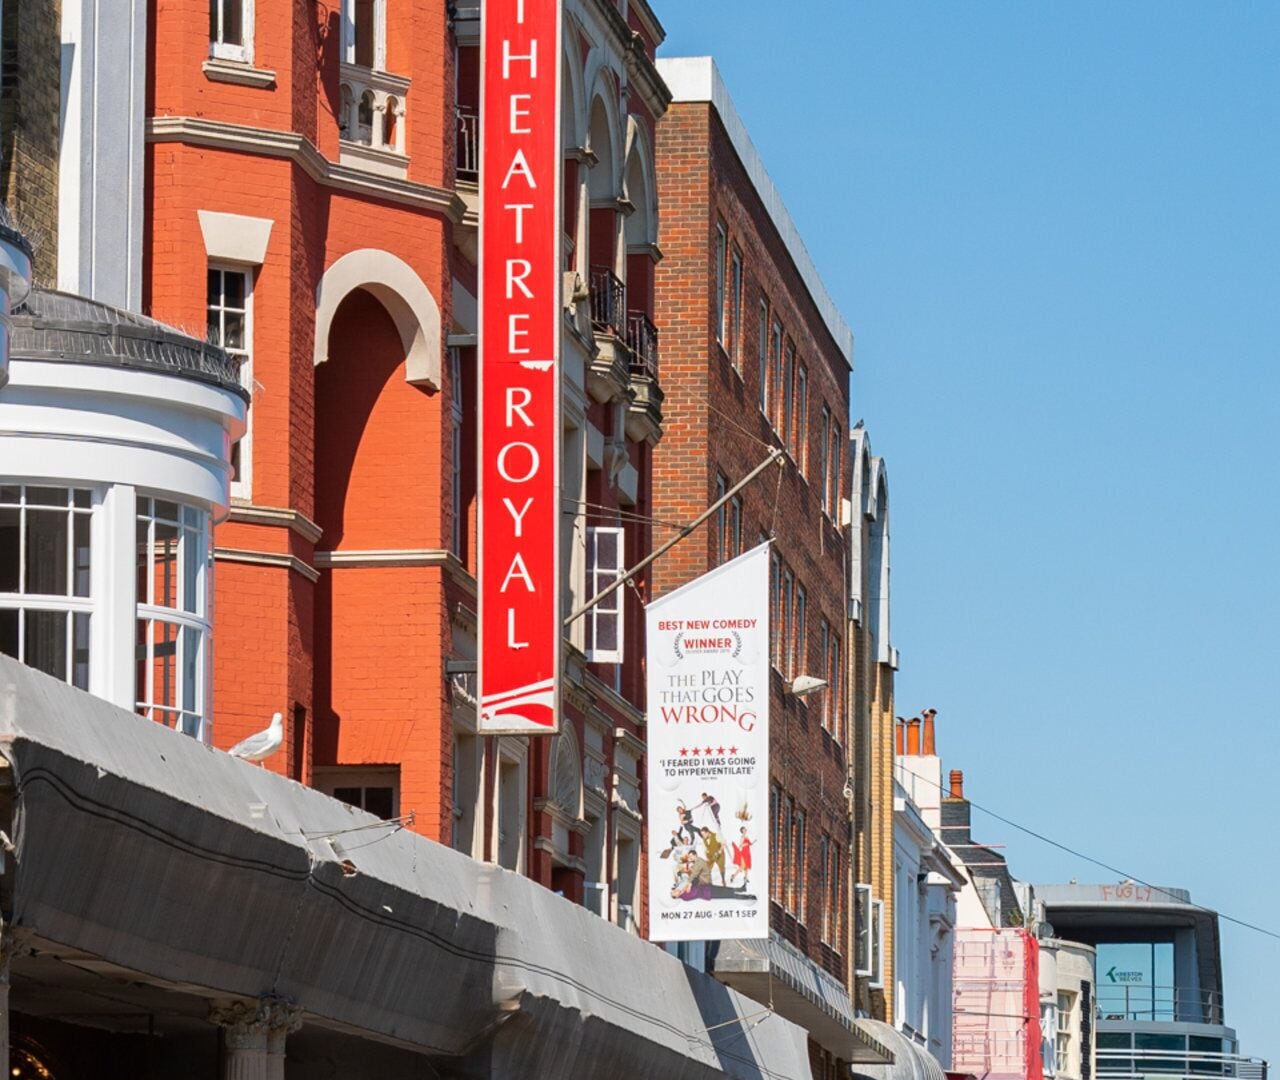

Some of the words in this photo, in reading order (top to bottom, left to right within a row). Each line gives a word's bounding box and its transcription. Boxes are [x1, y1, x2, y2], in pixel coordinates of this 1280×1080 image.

[497, 387, 541, 649] ROYAL
[658, 621, 683, 631] BEST
[686, 620, 710, 629] NEW
[712, 619, 757, 629] COMEDY
[684, 638, 732, 649] WINNER
[667, 675, 696, 687] THE
[701, 669, 743, 686] PLAY
[659, 690, 700, 703] THAT
[702, 687, 754, 703] GOES
[660, 704, 757, 732] WRONG
[667, 759, 700, 767] FEARED
[706, 758, 726, 766] WAS
[728, 757, 756, 765] GOING
[665, 768, 676, 776] TO
[1103, 884, 1151, 901] FUGLY
[660, 912, 681, 920] MON
[683, 911, 693, 919] 27
[694, 910, 712, 919] AUG
[719, 910, 734, 918] SAT
[741, 910, 757, 918] SEP
